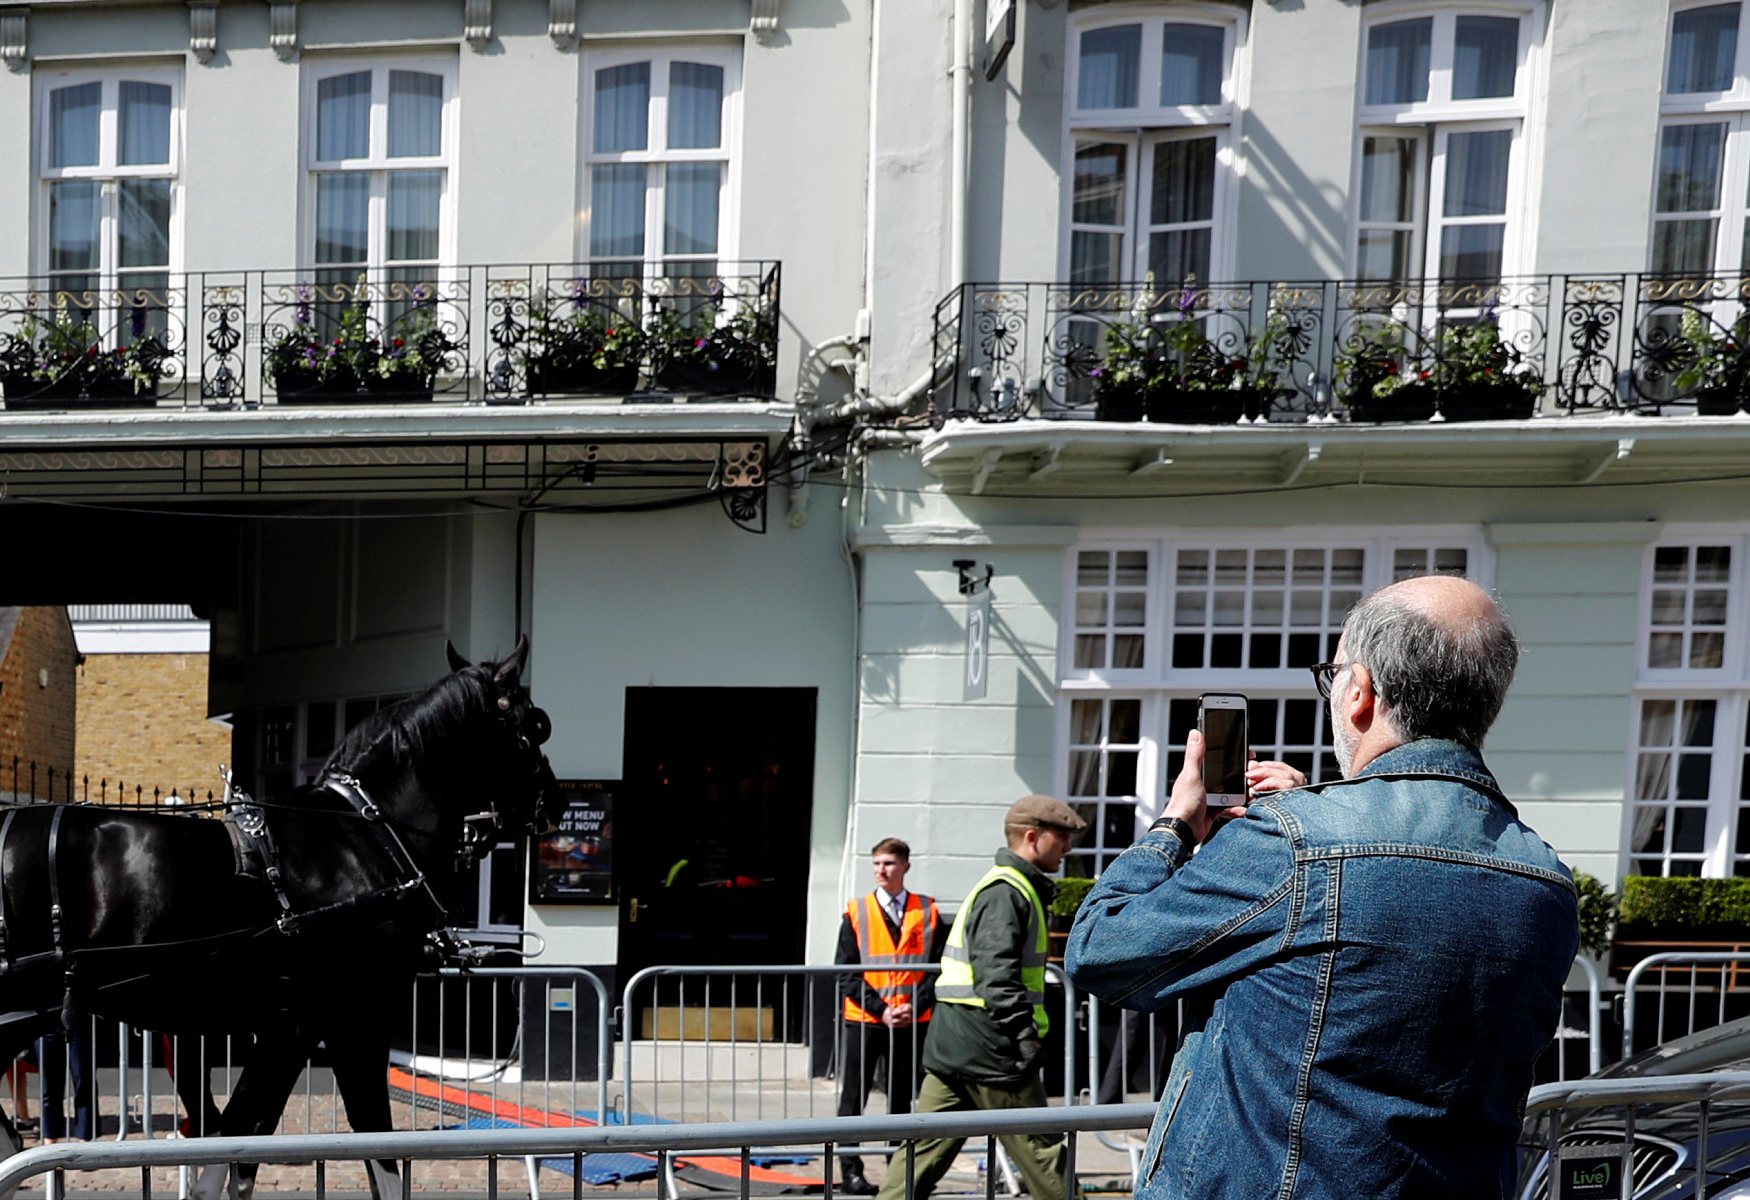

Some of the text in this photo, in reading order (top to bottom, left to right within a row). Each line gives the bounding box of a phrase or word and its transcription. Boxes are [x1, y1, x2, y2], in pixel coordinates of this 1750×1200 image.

[574, 811, 605, 820] MENU
[559, 821, 600, 831] UT NOW
[1573, 1170, 1605, 1184] Live
